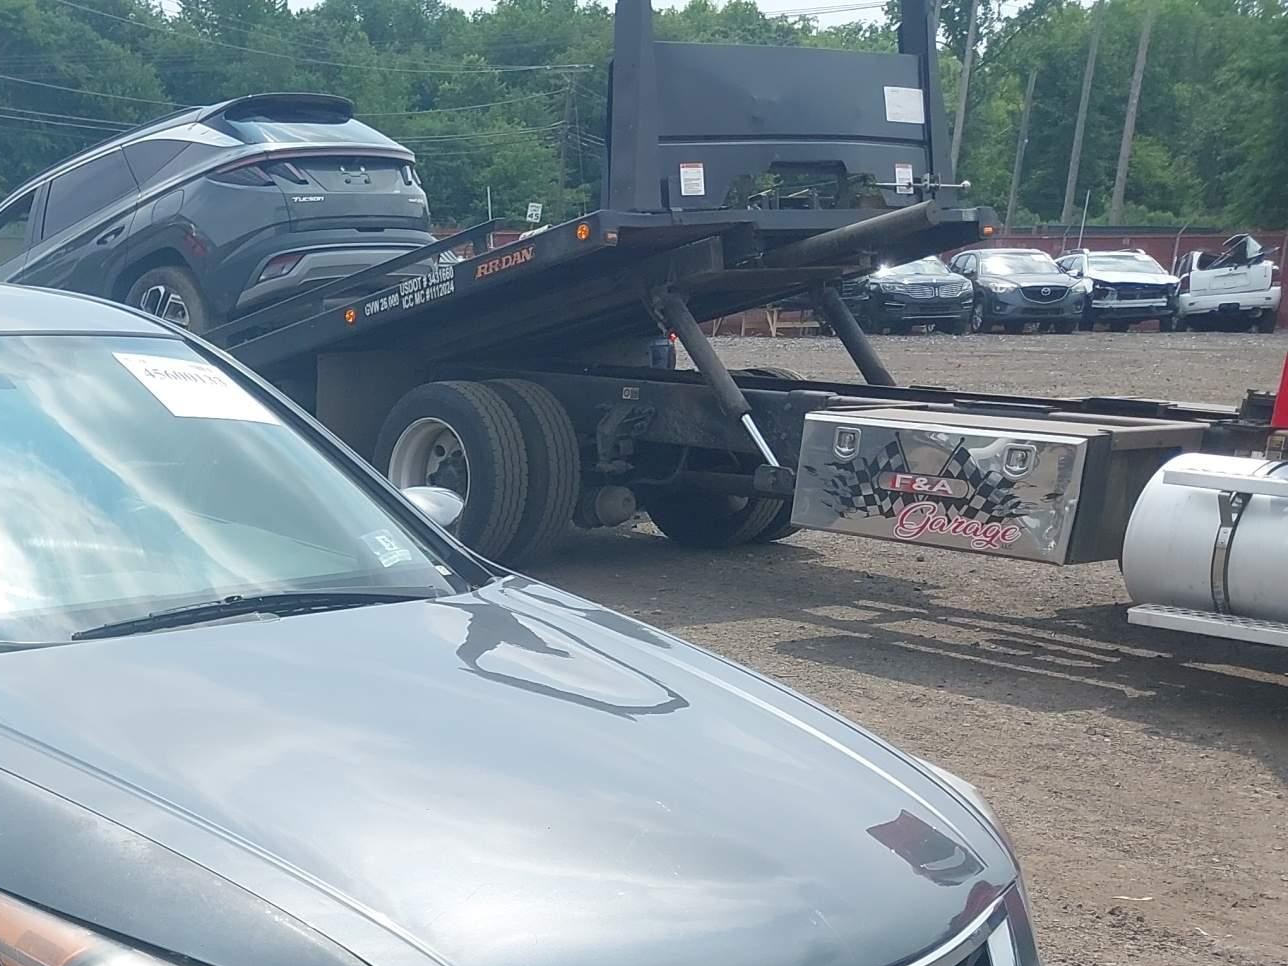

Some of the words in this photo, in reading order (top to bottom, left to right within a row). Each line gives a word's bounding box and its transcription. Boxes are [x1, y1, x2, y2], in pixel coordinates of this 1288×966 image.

[399, 277, 421, 295] USDOT
[365, 301, 379, 316] GVW
[403, 295, 414, 309] ICC
[414, 289, 425, 305] MC
[894, 473, 953, 495] F&A
[894, 501, 1021, 549] Garage
